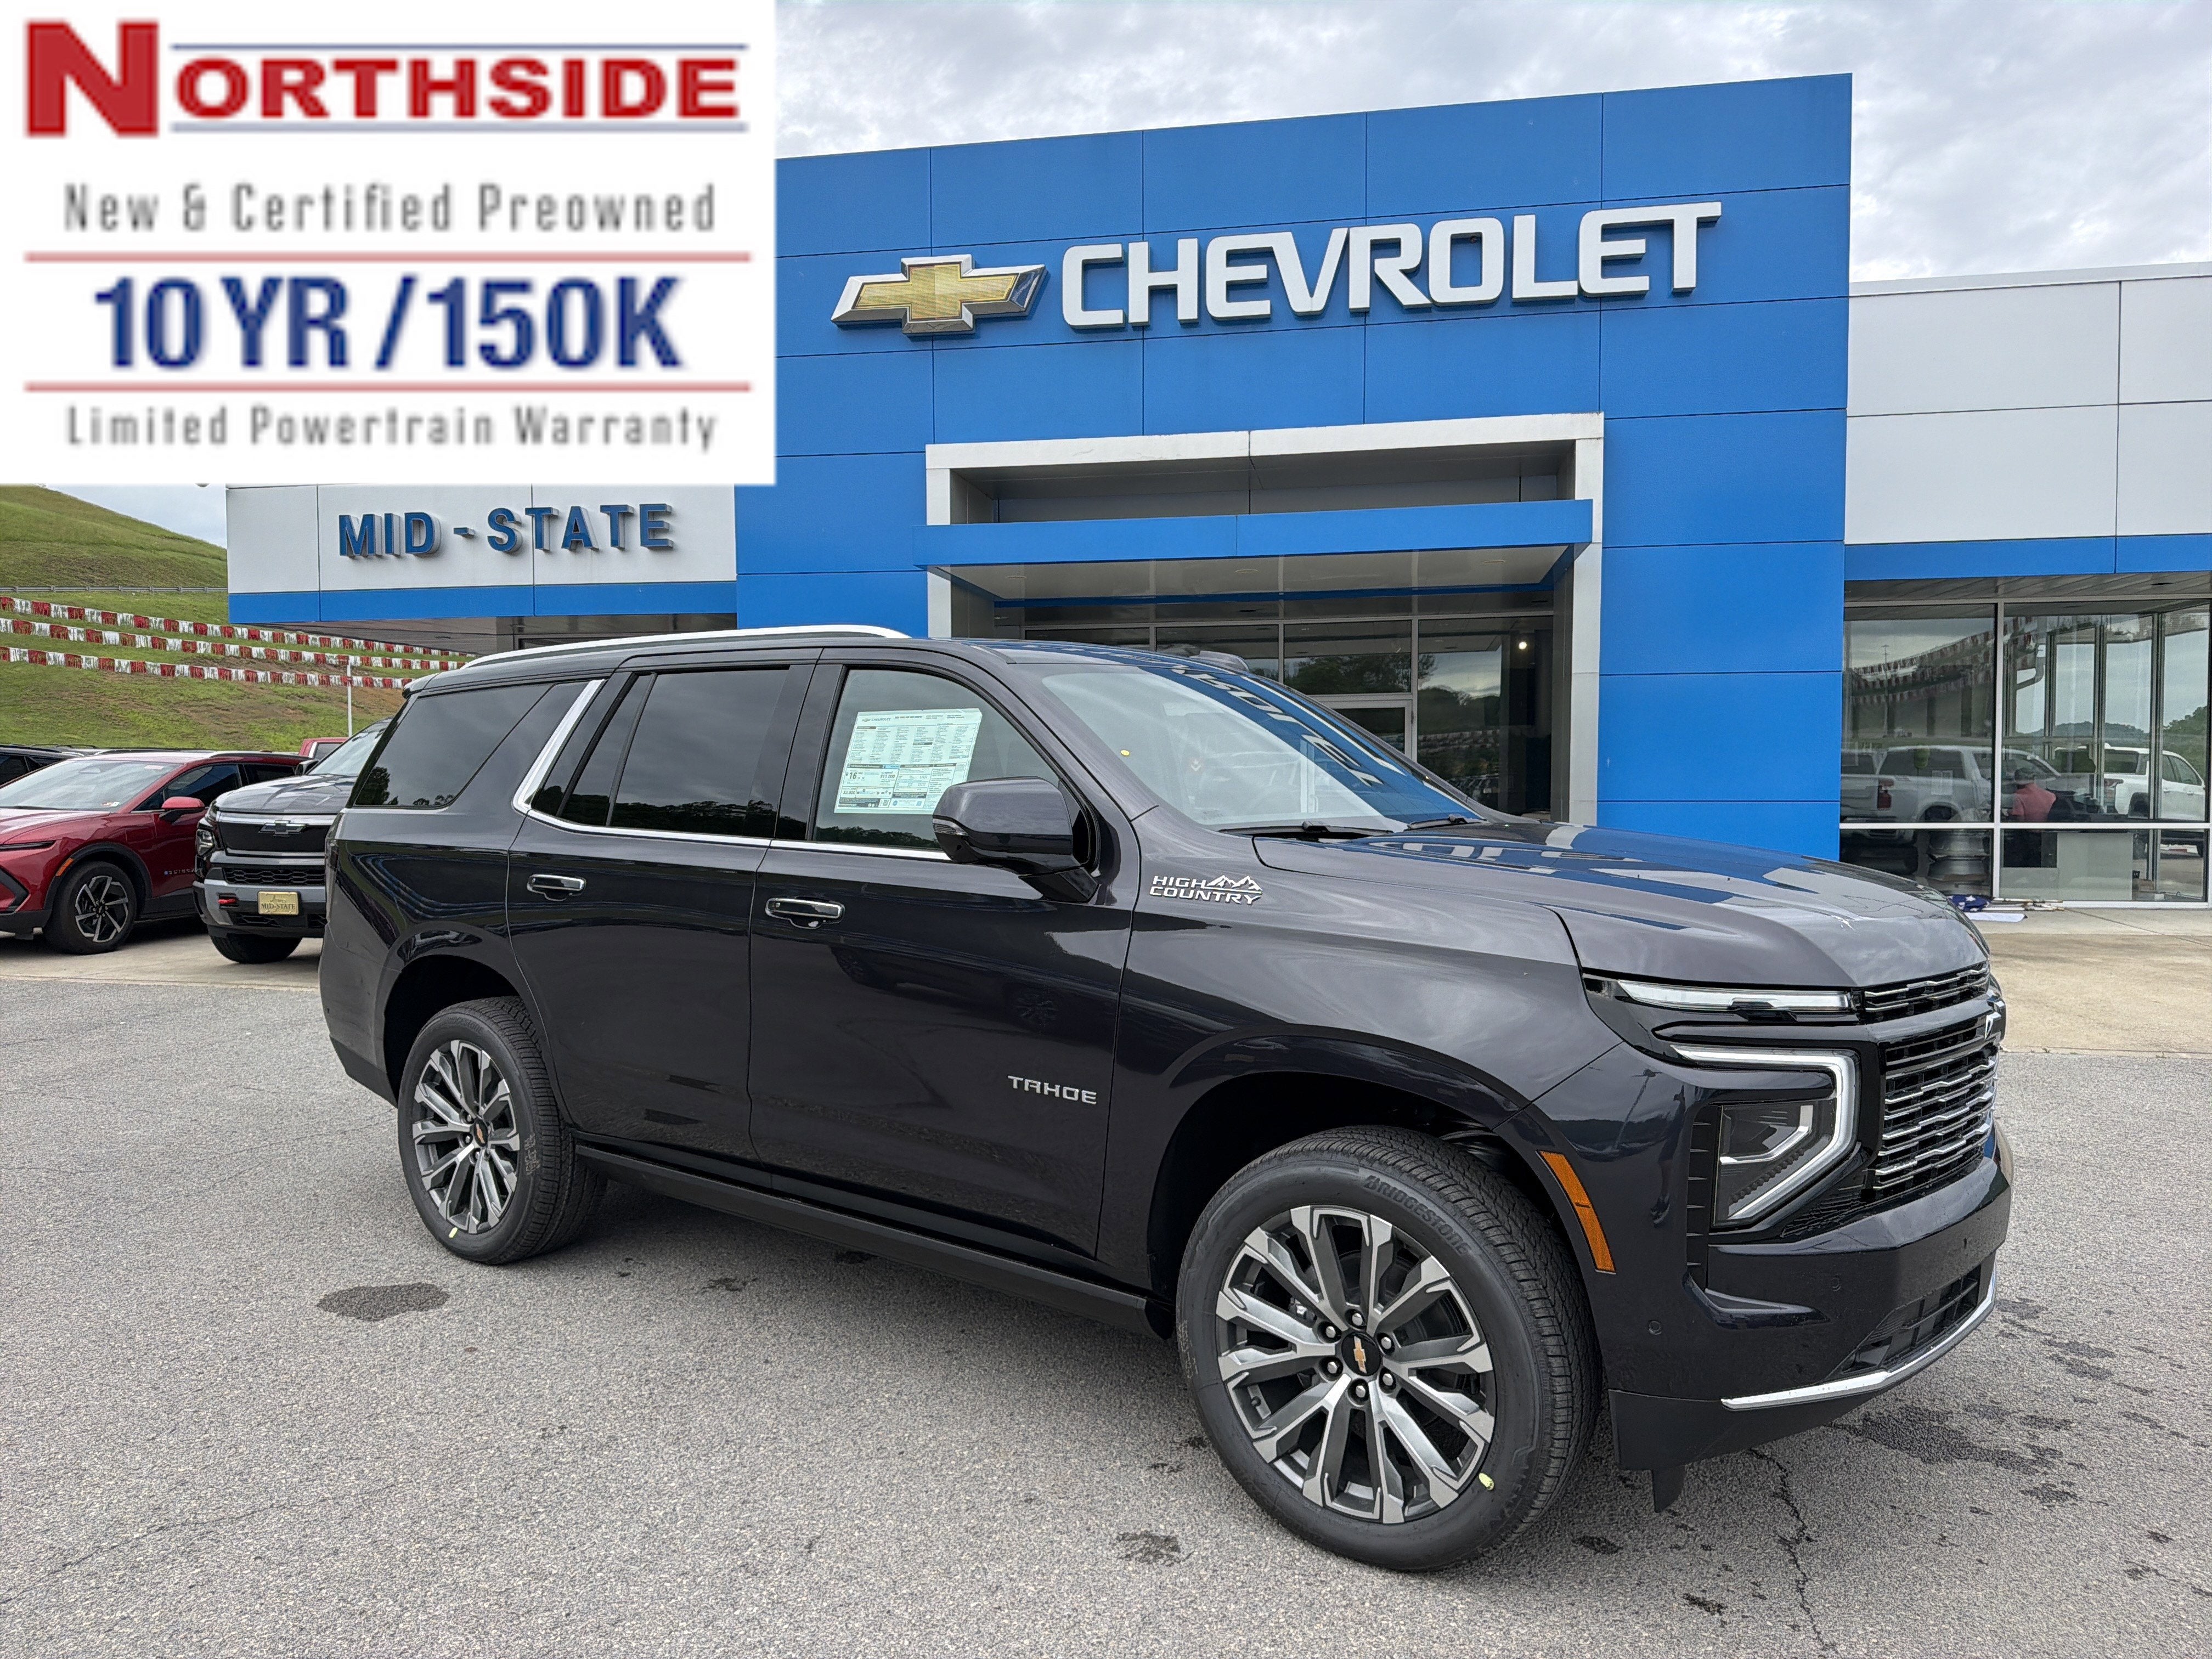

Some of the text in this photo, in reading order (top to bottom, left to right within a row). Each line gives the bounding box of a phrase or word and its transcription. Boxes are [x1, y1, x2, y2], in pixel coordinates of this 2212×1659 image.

[1062, 201, 1722, 328] CHEVROLET
[1149, 886, 1261, 905] COUNTRY
[1153, 875, 1207, 889] HIGH
[1007, 1075, 1097, 1105] TAHOE
[1363, 1175, 1472, 1255] BRIDGESTONE
